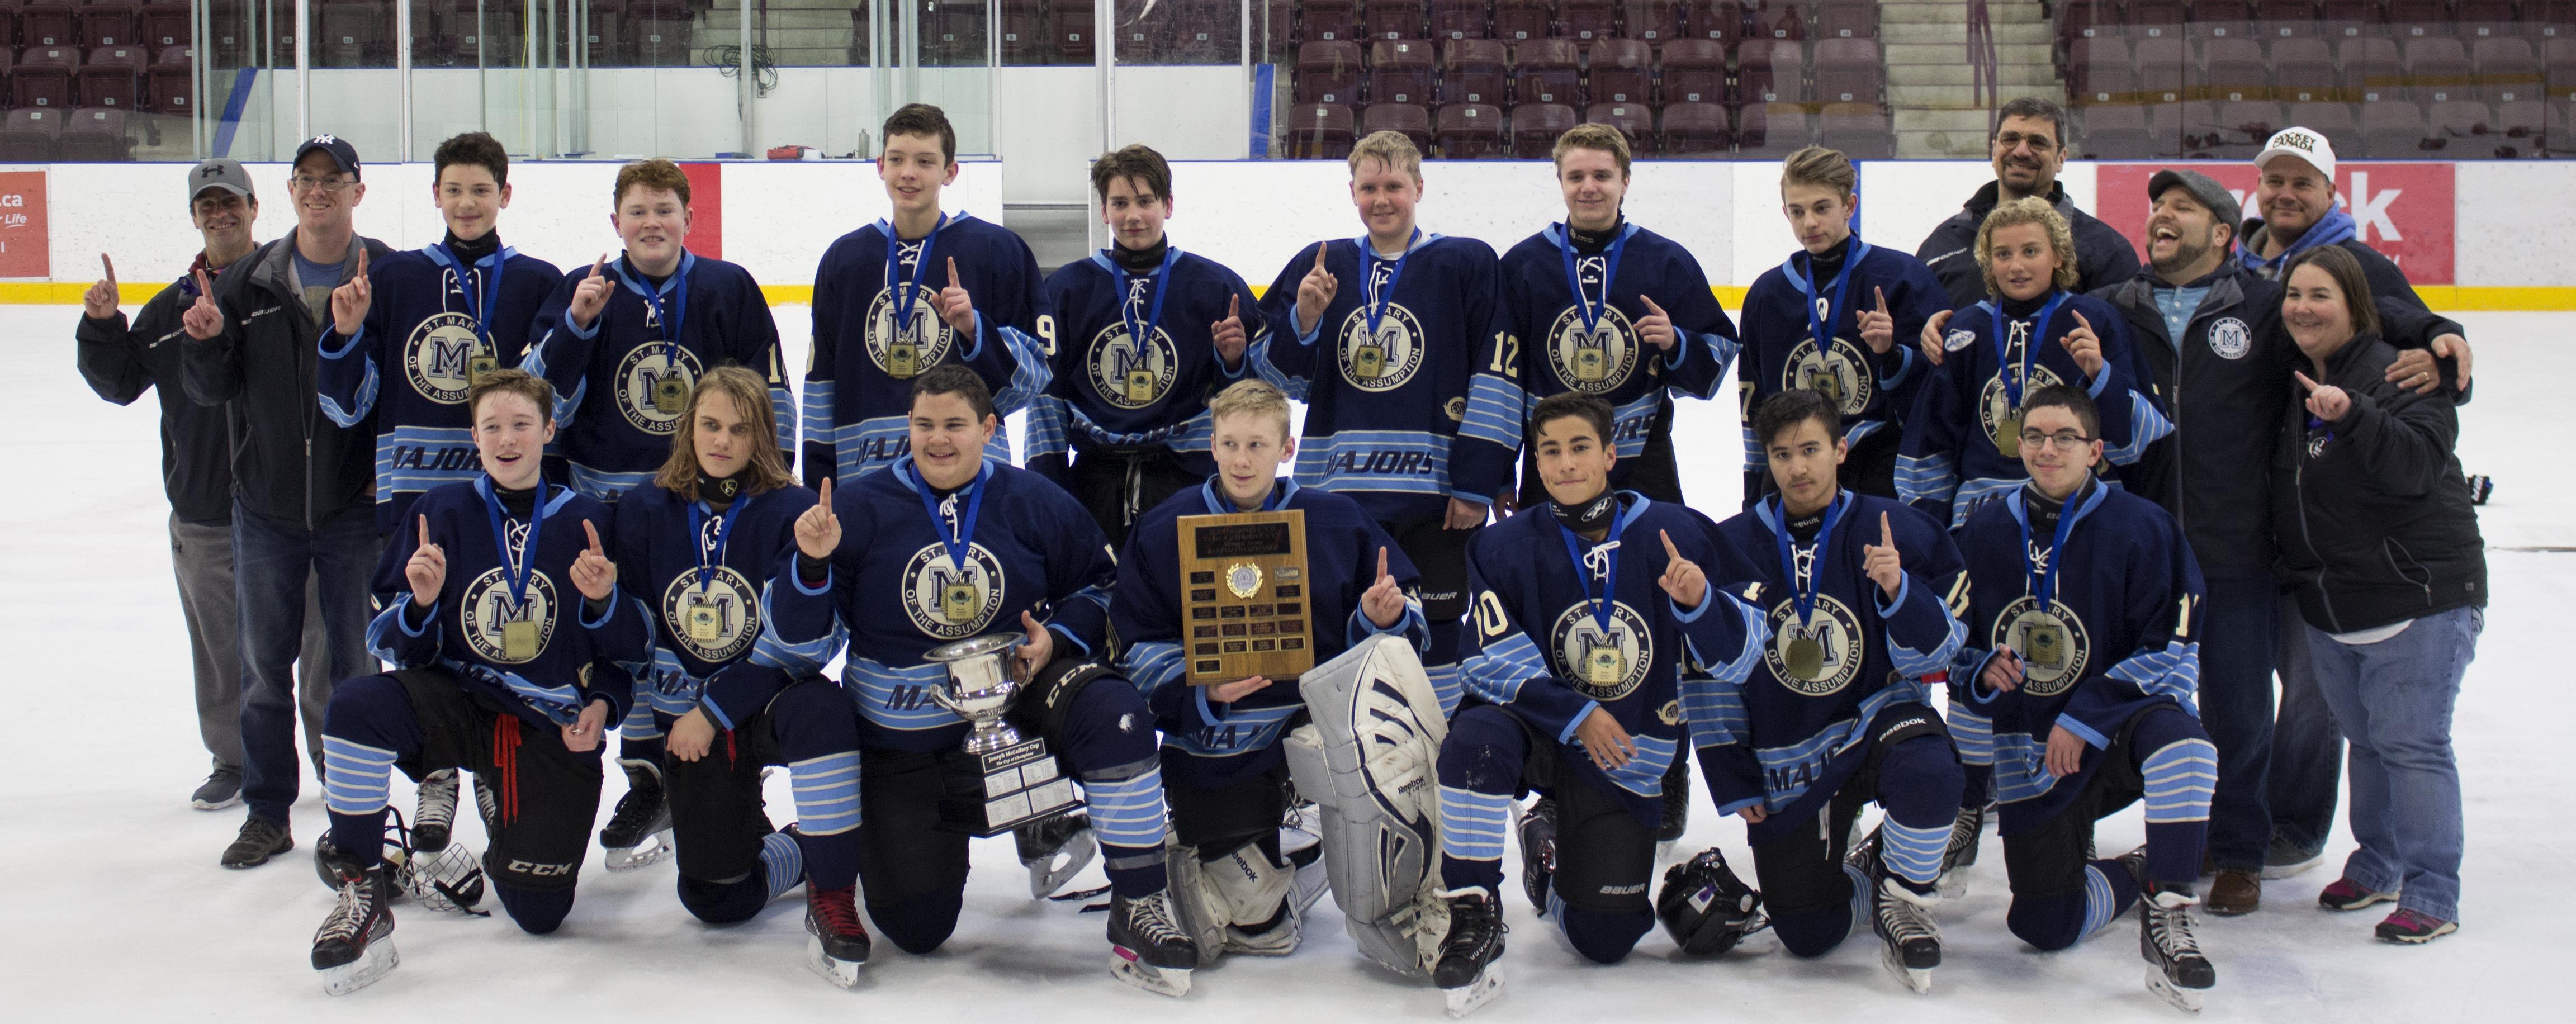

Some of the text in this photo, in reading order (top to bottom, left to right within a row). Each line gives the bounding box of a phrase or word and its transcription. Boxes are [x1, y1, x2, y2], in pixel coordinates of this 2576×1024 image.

[5, 214, 27, 224] Life
[878, 286, 933, 306] ST MRY
[251, 306, 281, 317] BAUER
[1353, 306, 1409, 324] ST ARY
[1562, 309, 1581, 325] ST.
[172, 326, 186, 338] BAU
[424, 316, 479, 335] ST. MAR
[1105, 327, 1120, 341] ST
[869, 330, 877, 347] OF
[2219, 327, 2241, 348] M
[630, 347, 650, 365] ST.
[1490, 330, 1519, 378] 12
[1793, 343, 1848, 363] ST. MRY
[409, 355, 416, 369] OF
[413, 372, 431, 394] THE
[1341, 348, 1348, 365] OF
[1362, 348, 1420, 388] ASSUMPTION
[1551, 347, 1635, 391] OF THE ASSUMPTION
[1091, 363, 1099, 378] OF
[1097, 380, 1117, 404] THE
[619, 388, 646, 426] OF THE
[1983, 410, 1992, 426] OF
[1322, 450, 1434, 480] MAJORS
[1793, 516, 1820, 528] eebok
[920, 546, 943, 562] ST.
[713, 570, 742, 590] ARY
[1420, 591, 1458, 601] AUER
[466, 611, 475, 627] OF
[906, 588, 1000, 636] OF THE ASSUMPTION
[1472, 590, 1509, 648] 10
[1566, 611, 1588, 625] ST.
[1777, 600, 1840, 622] ST ARY
[2011, 600, 2070, 622] ST. MRY
[470, 630, 491, 652] THE
[667, 611, 756, 659] OF THE ASSUMPTION
[1555, 648, 1650, 697] OF THE ASSUMPTION
[1769, 639, 1859, 692] OF THE ASSUMPTION
[2024, 648, 2085, 692] ASSUMPTION
[1045, 663, 1098, 709] CCM
[988, 753, 1005, 764] Joseph
[1398, 775, 1426, 795] Reebok
[507, 859, 572, 876] CCM
[1231, 851, 1259, 883] eebok
[1599, 882, 1646, 895] BAUER
